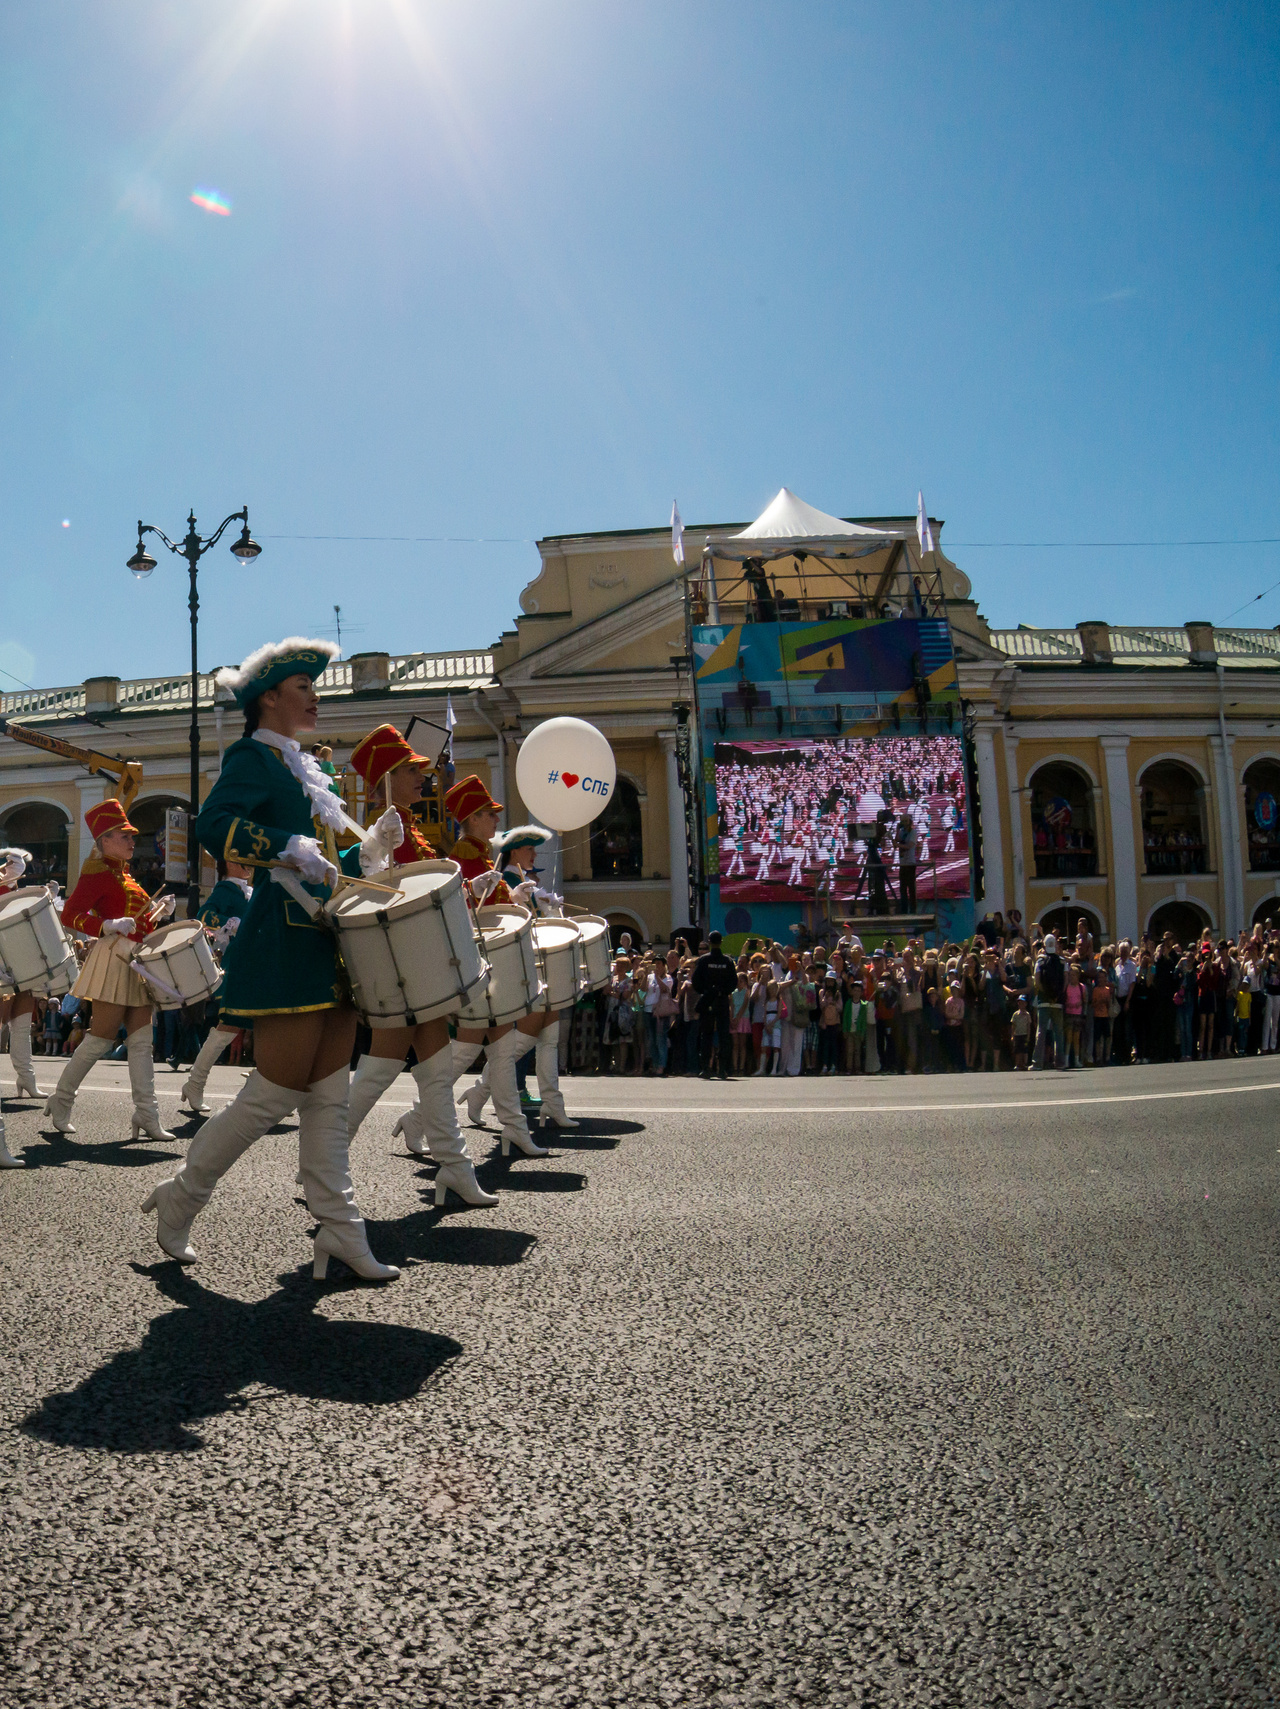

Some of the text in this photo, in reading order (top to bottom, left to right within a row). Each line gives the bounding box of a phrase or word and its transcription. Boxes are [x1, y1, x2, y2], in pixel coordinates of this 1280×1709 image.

[12, 725, 49, 746] Haulotte
[547, 770, 610, 796] # СПБ
